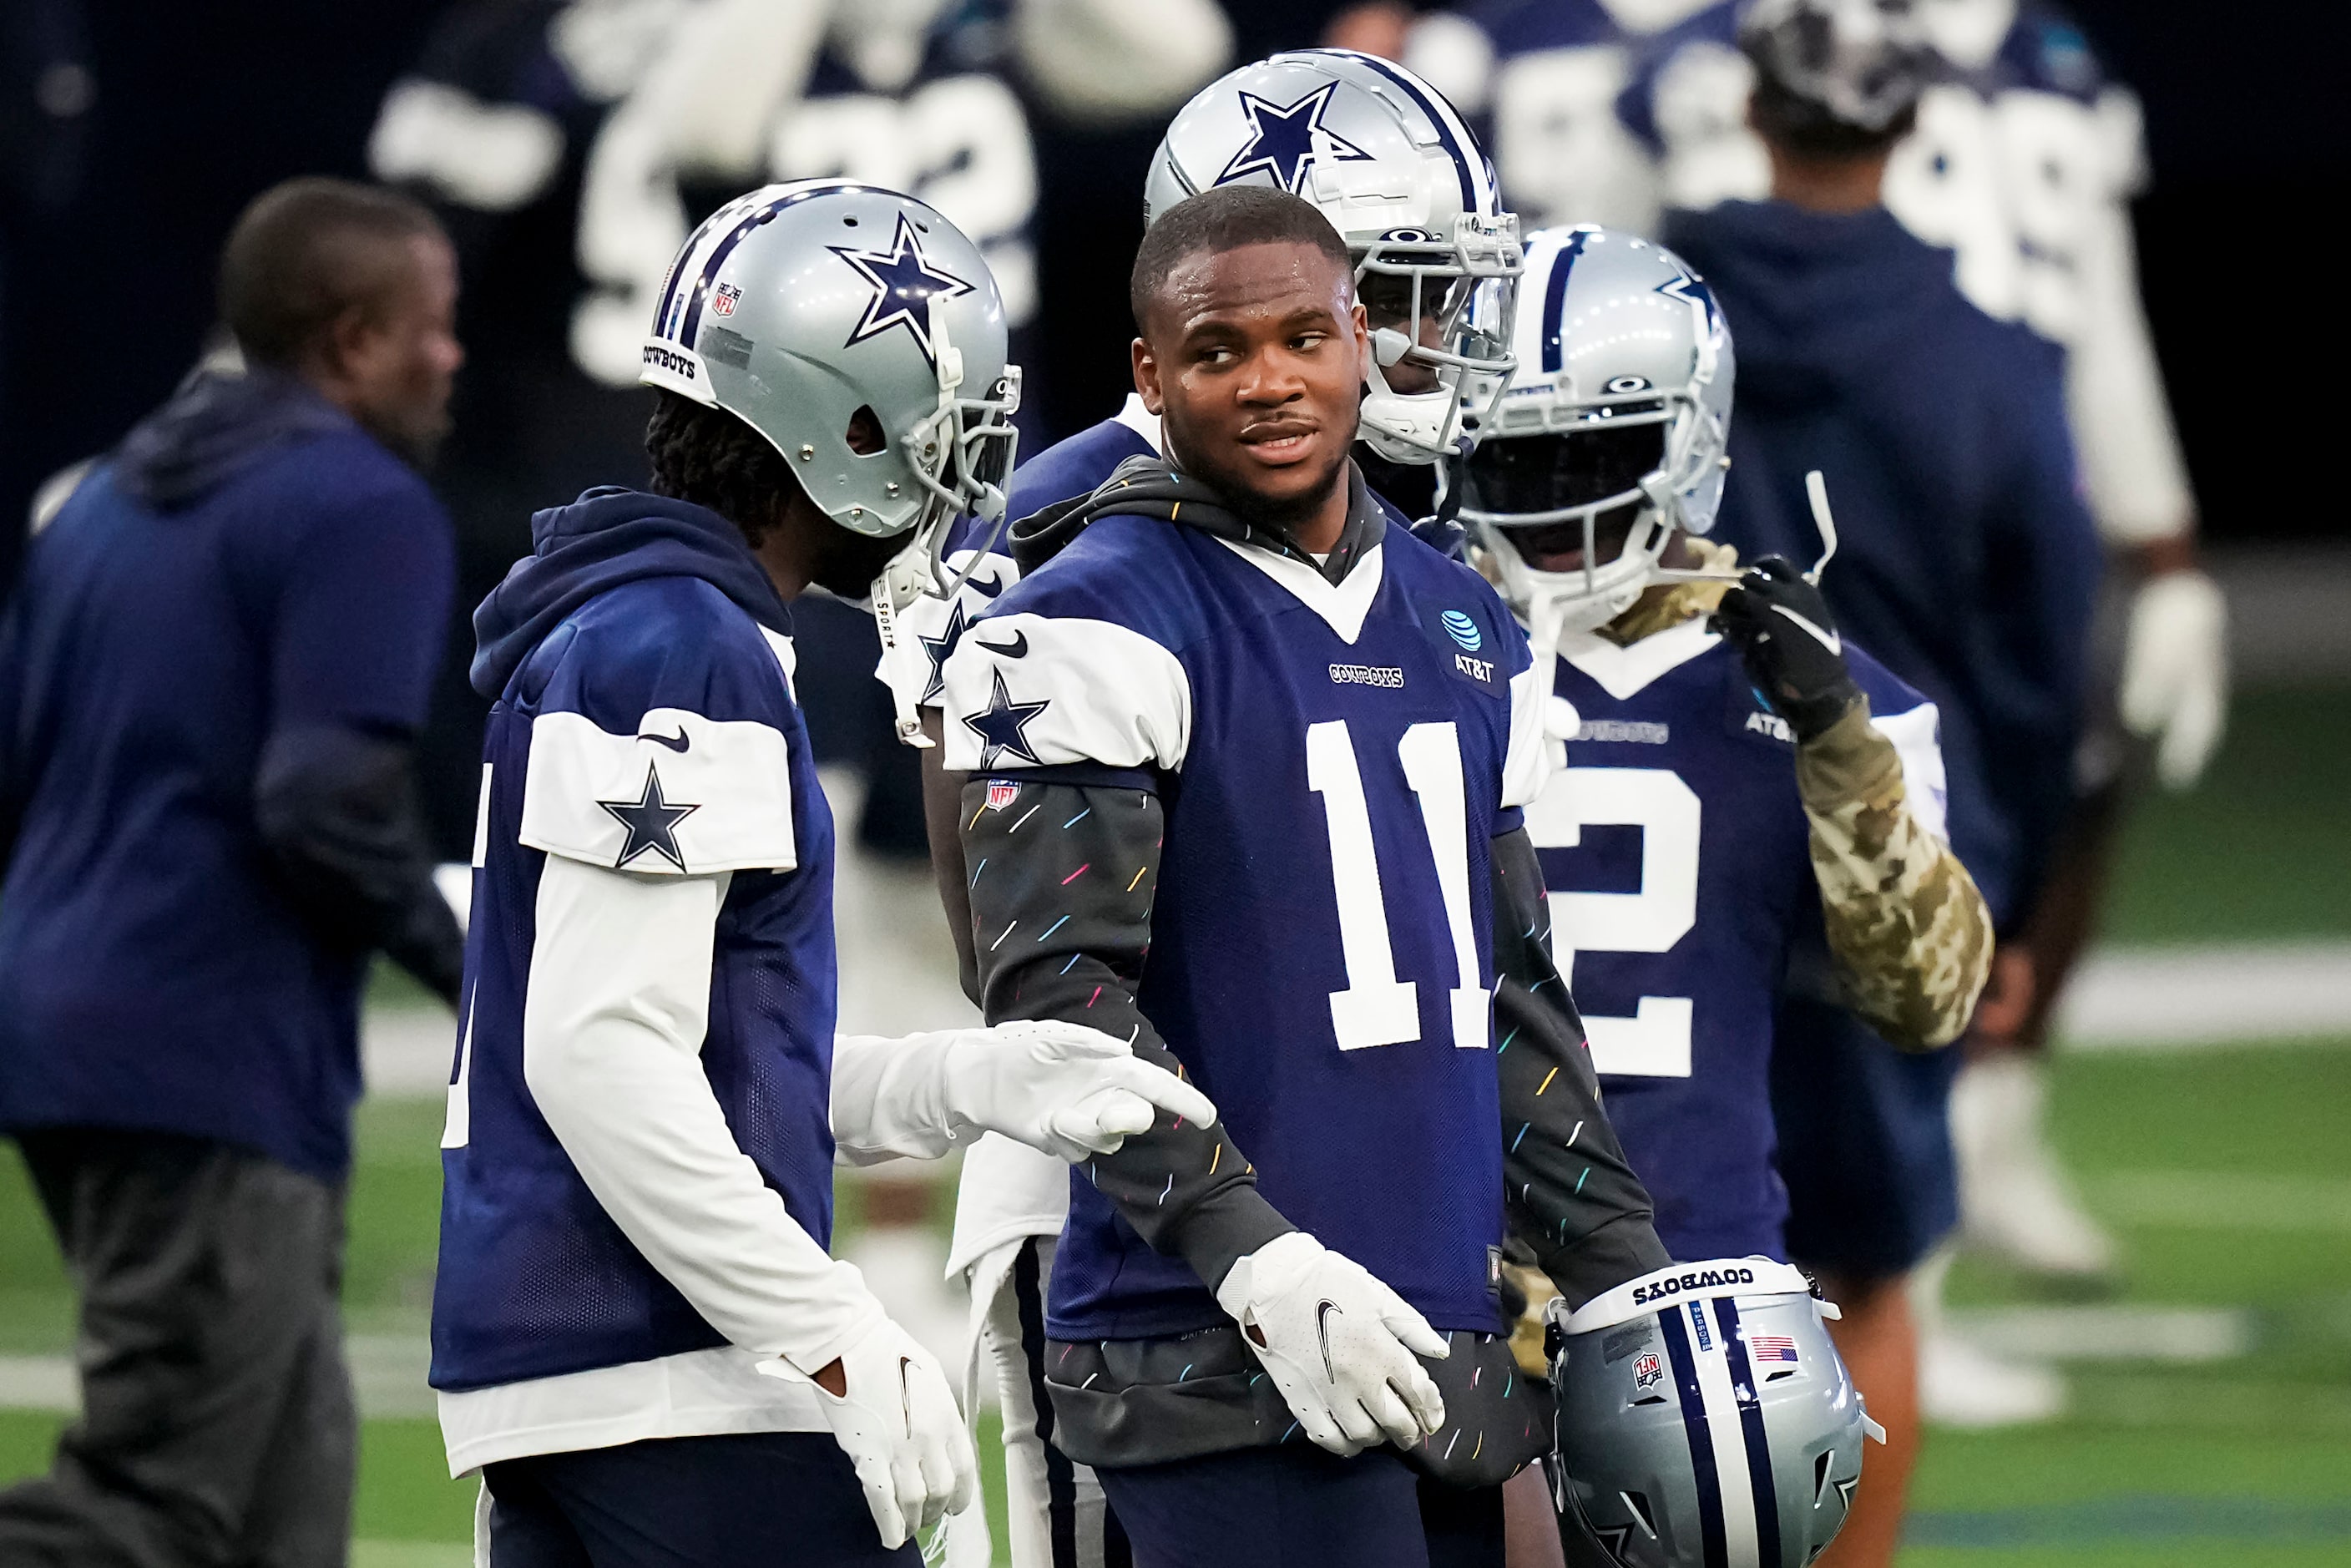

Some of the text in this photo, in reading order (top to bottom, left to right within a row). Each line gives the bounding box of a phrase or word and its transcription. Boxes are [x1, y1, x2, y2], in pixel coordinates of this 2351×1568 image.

[715, 294, 733, 313] NFL
[643, 345, 695, 380] COWBOYS
[1328, 663, 1405, 689] COWBOYS
[1454, 653, 1494, 684] AT&T
[990, 787, 1014, 805] NFL
[1305, 718, 1491, 1051] 11
[1523, 766, 1702, 1079] 2
[1632, 1268, 1753, 1306] COWBOYS
[1636, 1356, 1658, 1375] NFL
